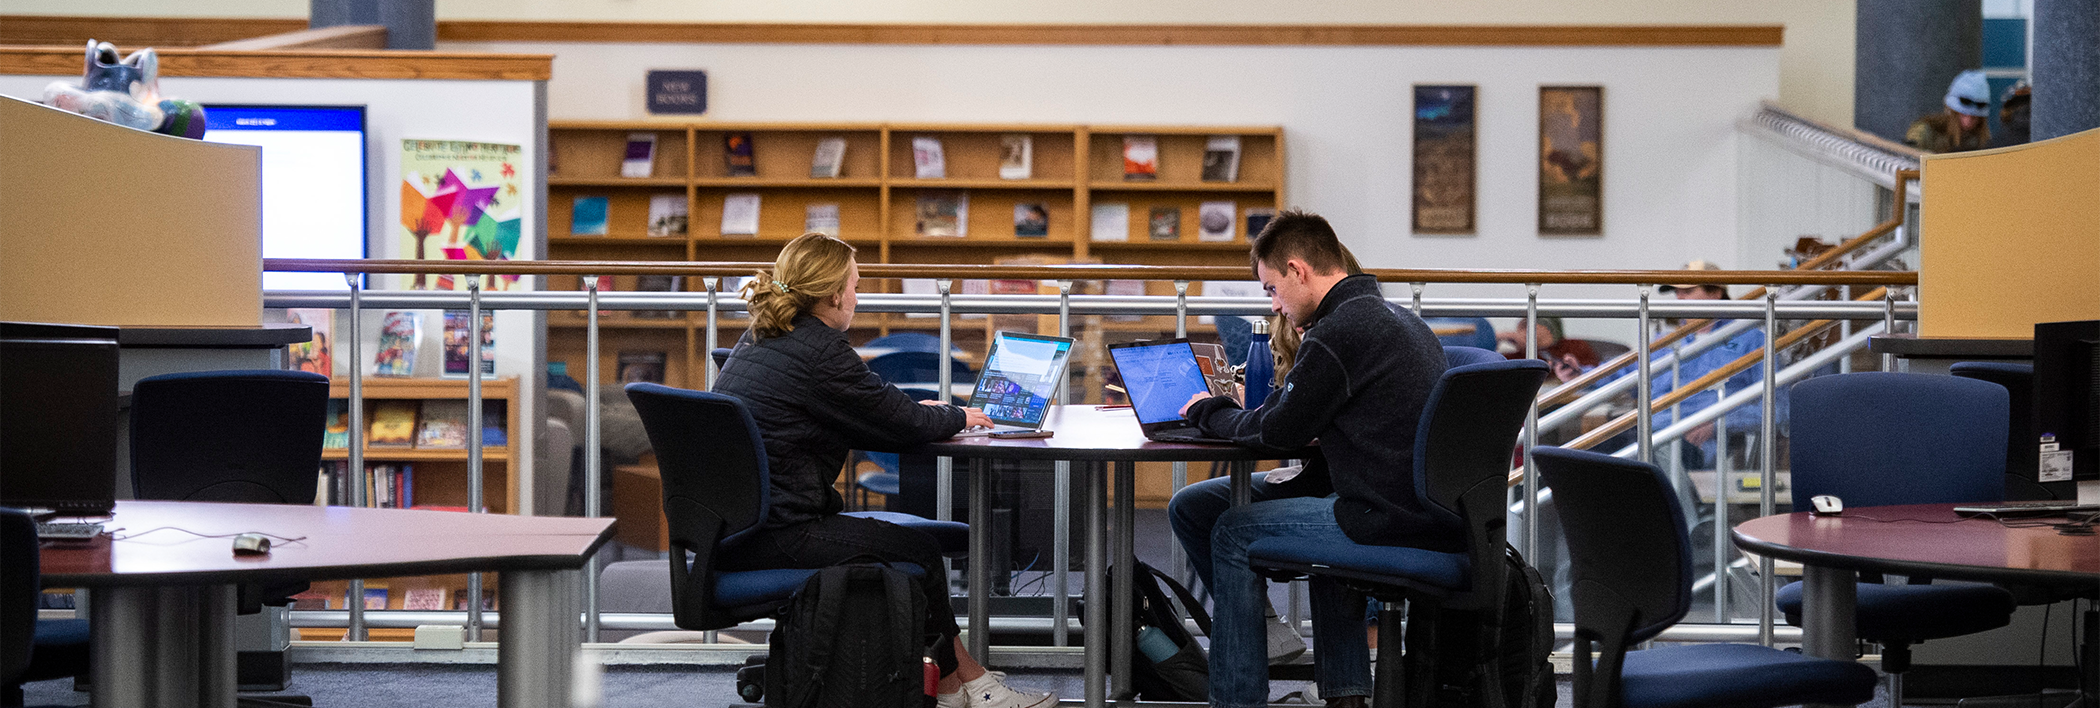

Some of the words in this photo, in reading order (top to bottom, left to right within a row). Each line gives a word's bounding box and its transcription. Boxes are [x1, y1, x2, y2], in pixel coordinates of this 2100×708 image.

[662, 81, 690, 92] NEW
[656, 94, 696, 105] BOOKS
[403, 139, 448, 153] CELEBRATE
